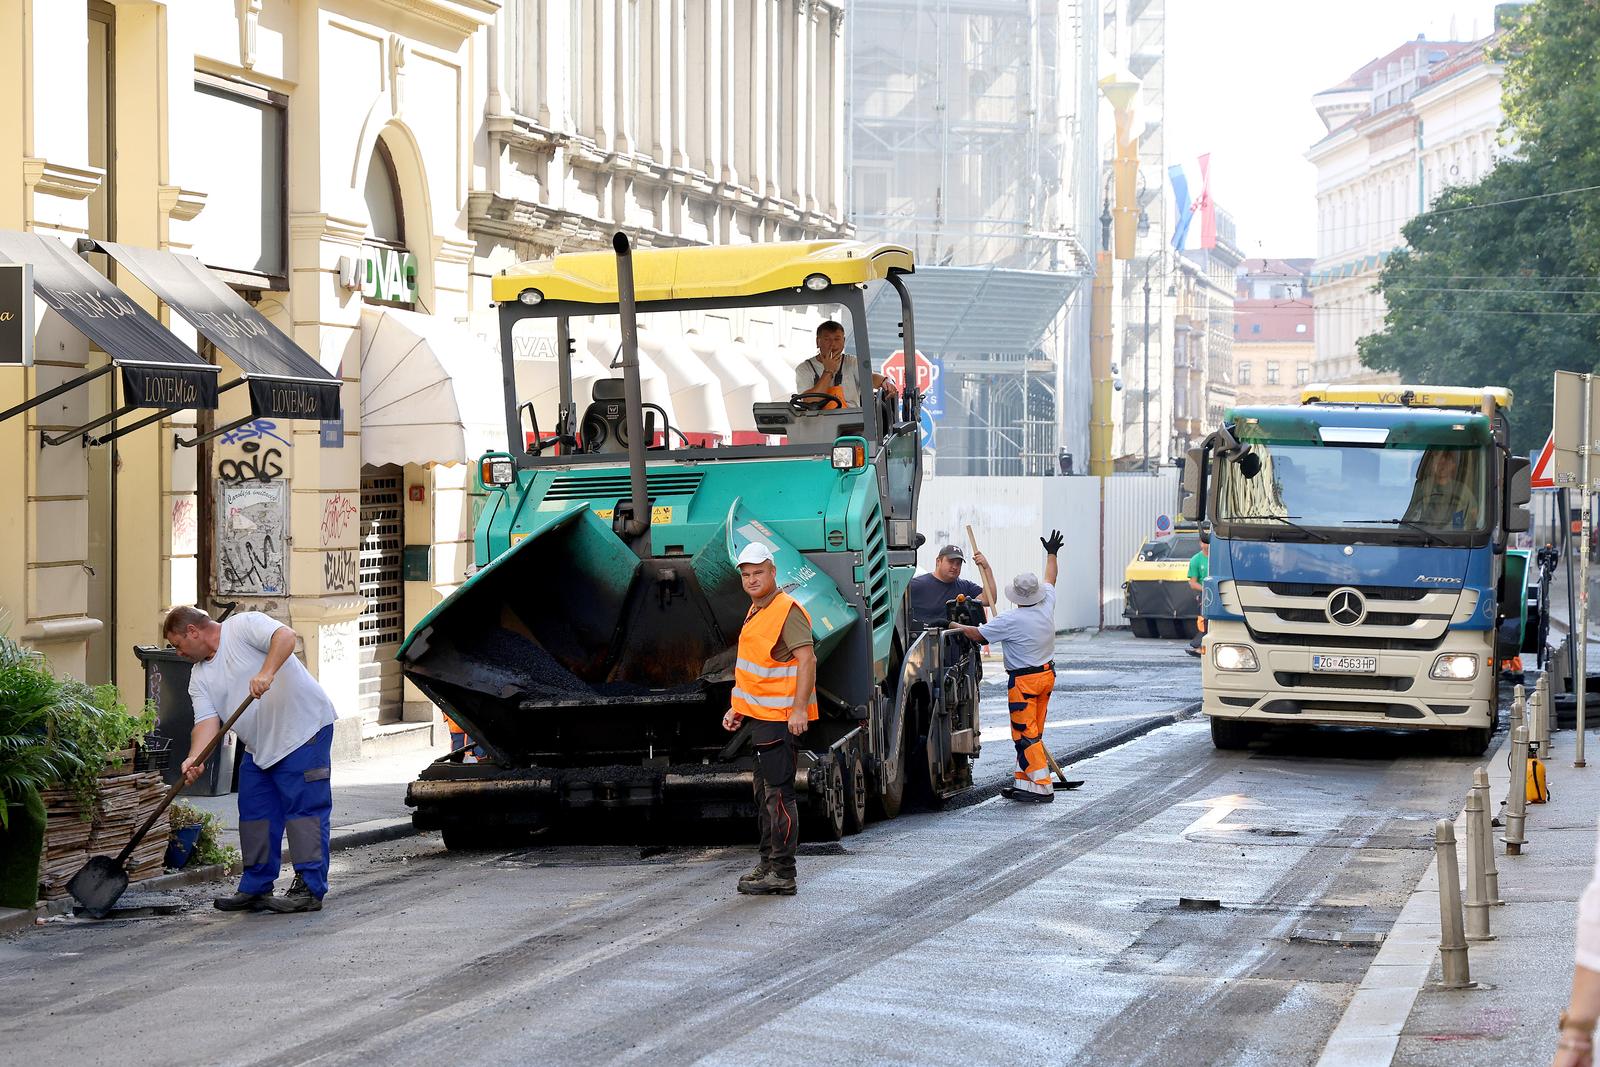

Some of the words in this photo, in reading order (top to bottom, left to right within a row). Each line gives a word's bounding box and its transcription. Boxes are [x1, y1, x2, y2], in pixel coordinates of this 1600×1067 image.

[886, 365, 928, 386] STP
[145, 376, 197, 404] LOVEMia
[272, 388, 317, 414] LOVEMia
[1320, 657, 1332, 668] ZG
